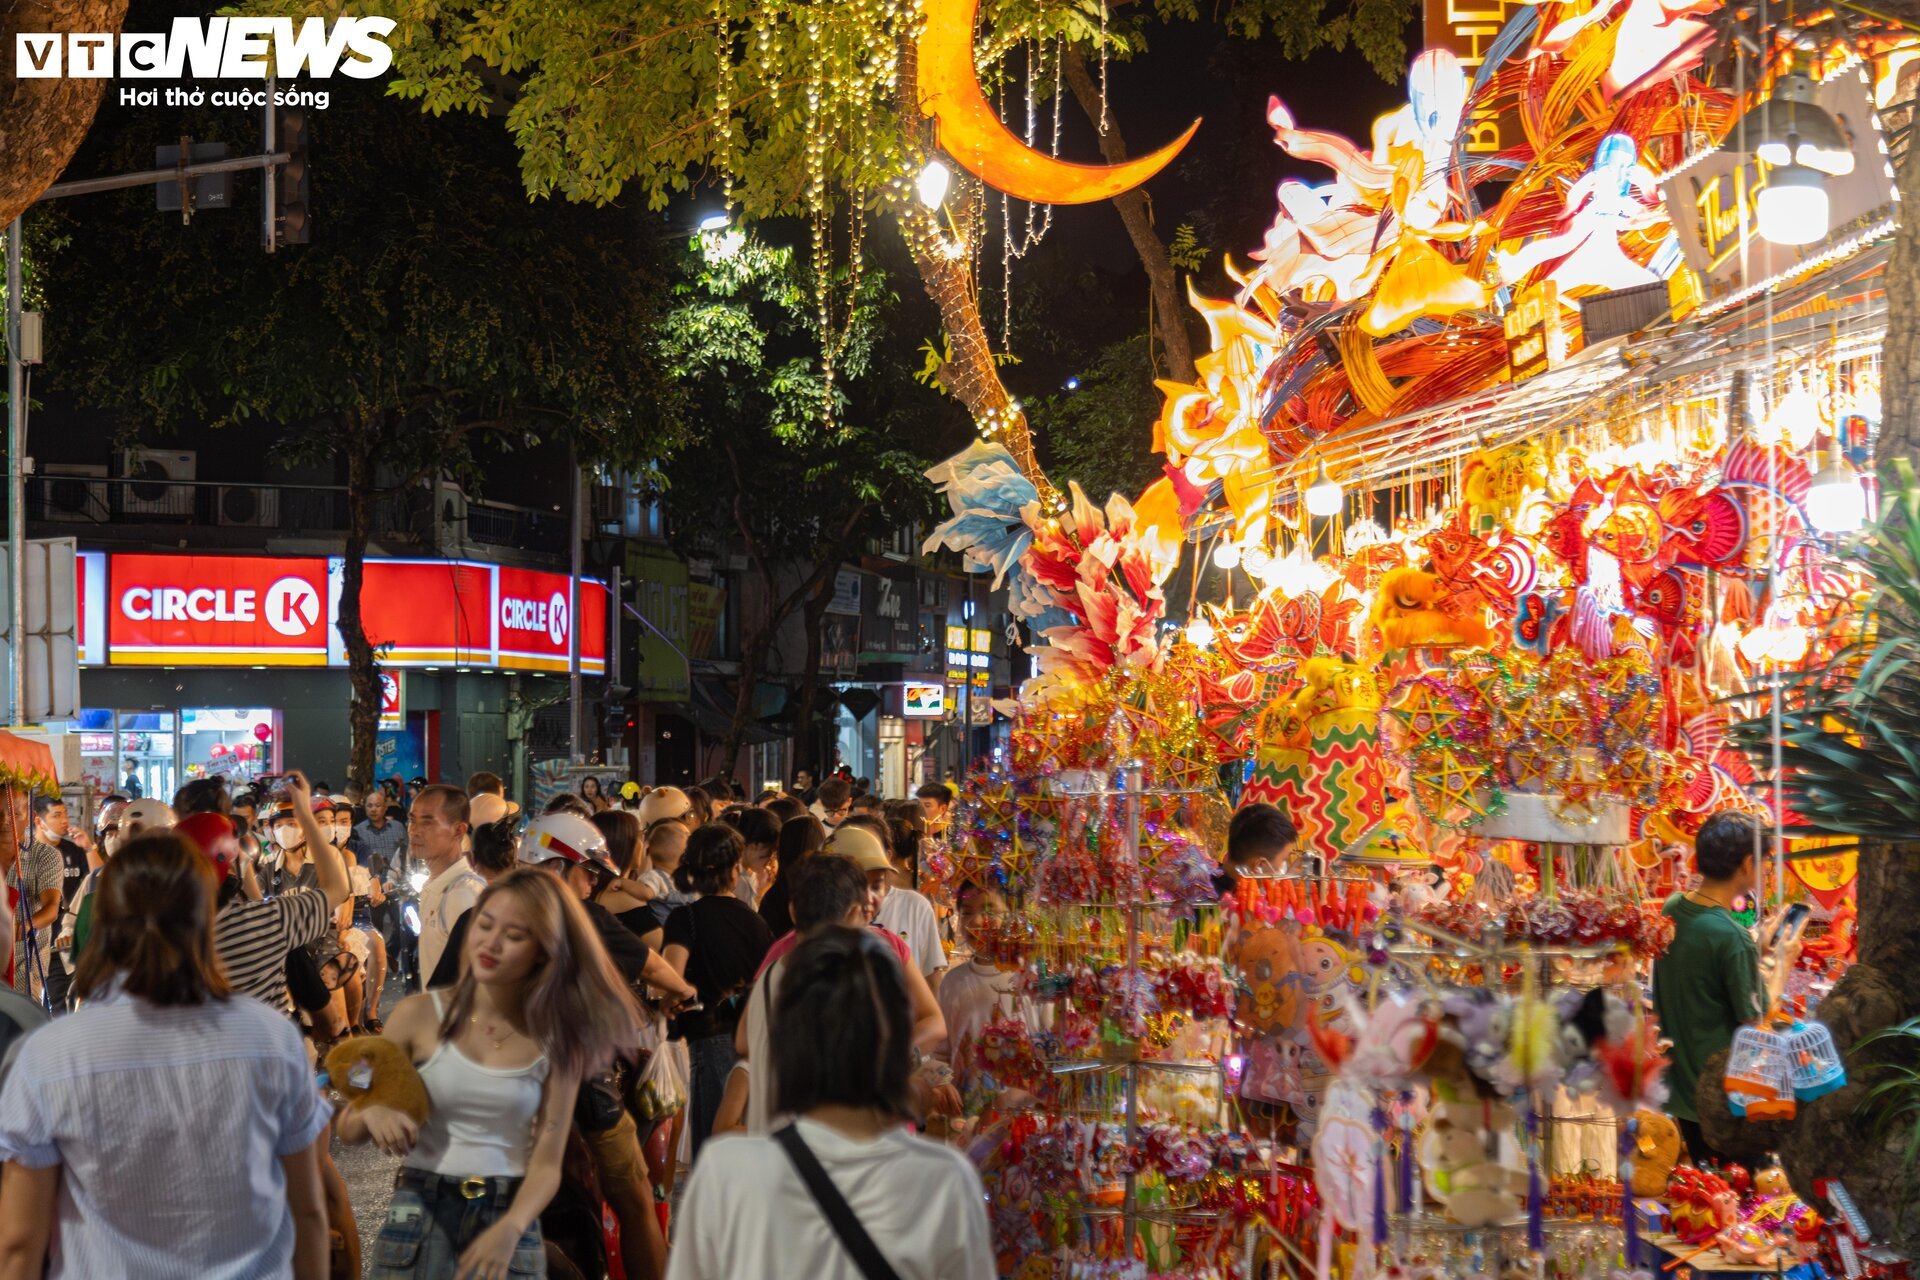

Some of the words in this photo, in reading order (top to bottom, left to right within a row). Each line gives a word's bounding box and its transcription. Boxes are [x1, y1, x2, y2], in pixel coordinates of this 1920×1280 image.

[122, 587, 256, 622] CIRCLE
[274, 582, 317, 634] K
[502, 598, 547, 632] CIRCLE
[551, 596, 567, 642] K
